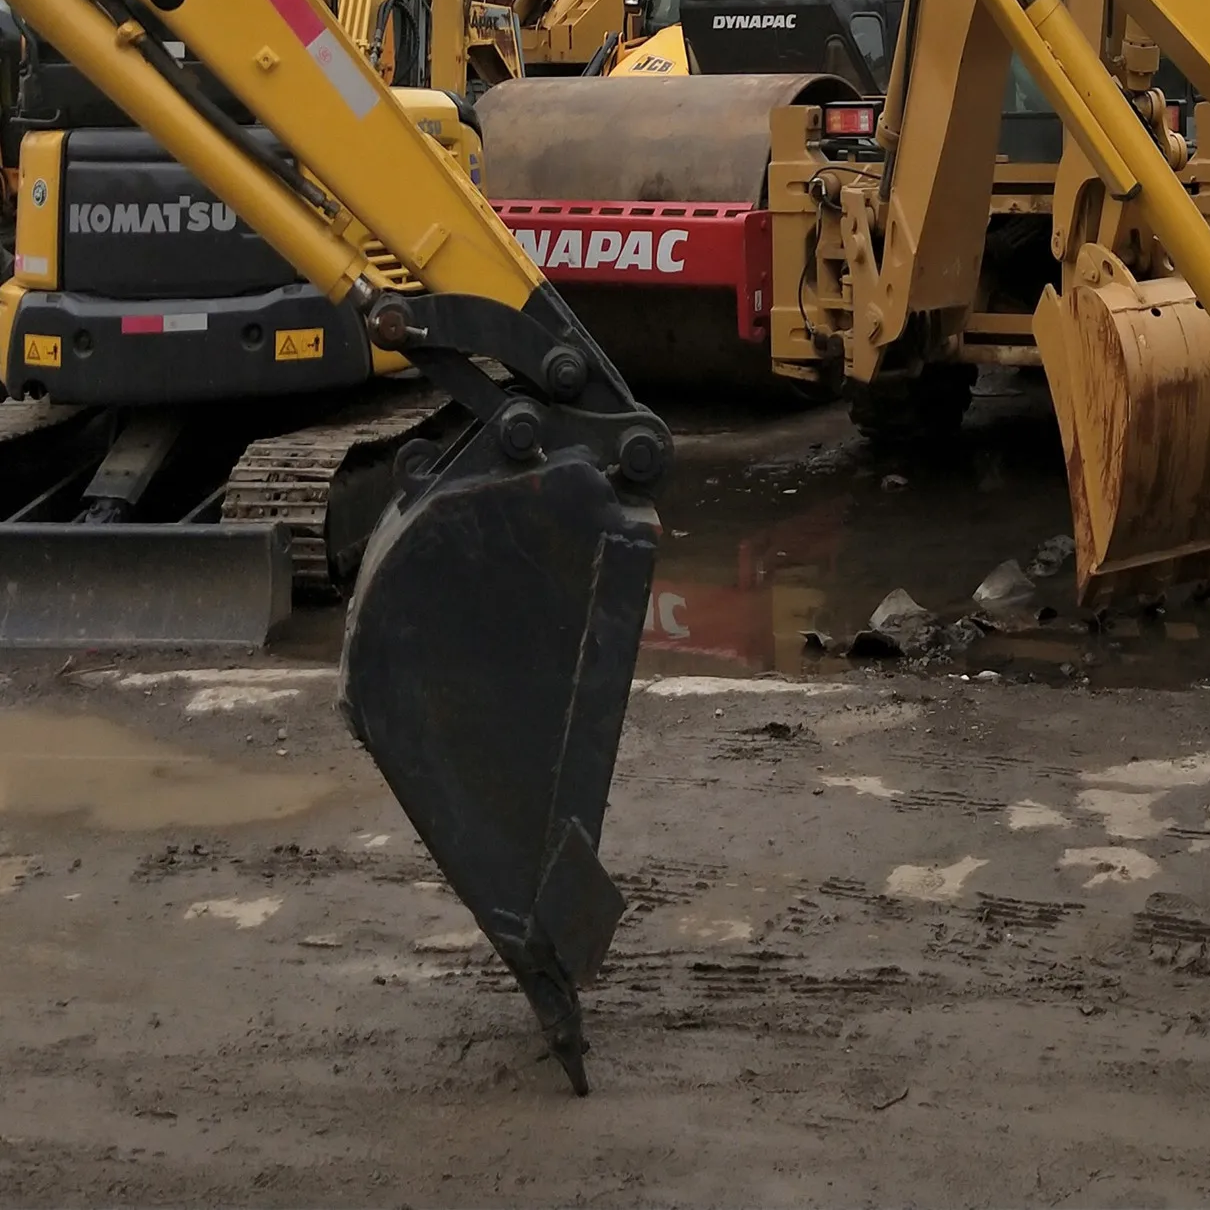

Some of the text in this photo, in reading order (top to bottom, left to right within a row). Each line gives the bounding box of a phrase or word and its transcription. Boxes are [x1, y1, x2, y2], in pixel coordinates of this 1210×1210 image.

[712, 14, 797, 29] DYNAPAC
[632, 56, 674, 73] JCB
[69, 195, 237, 233] KOMATSU
[510, 229, 689, 273] NAPAC
